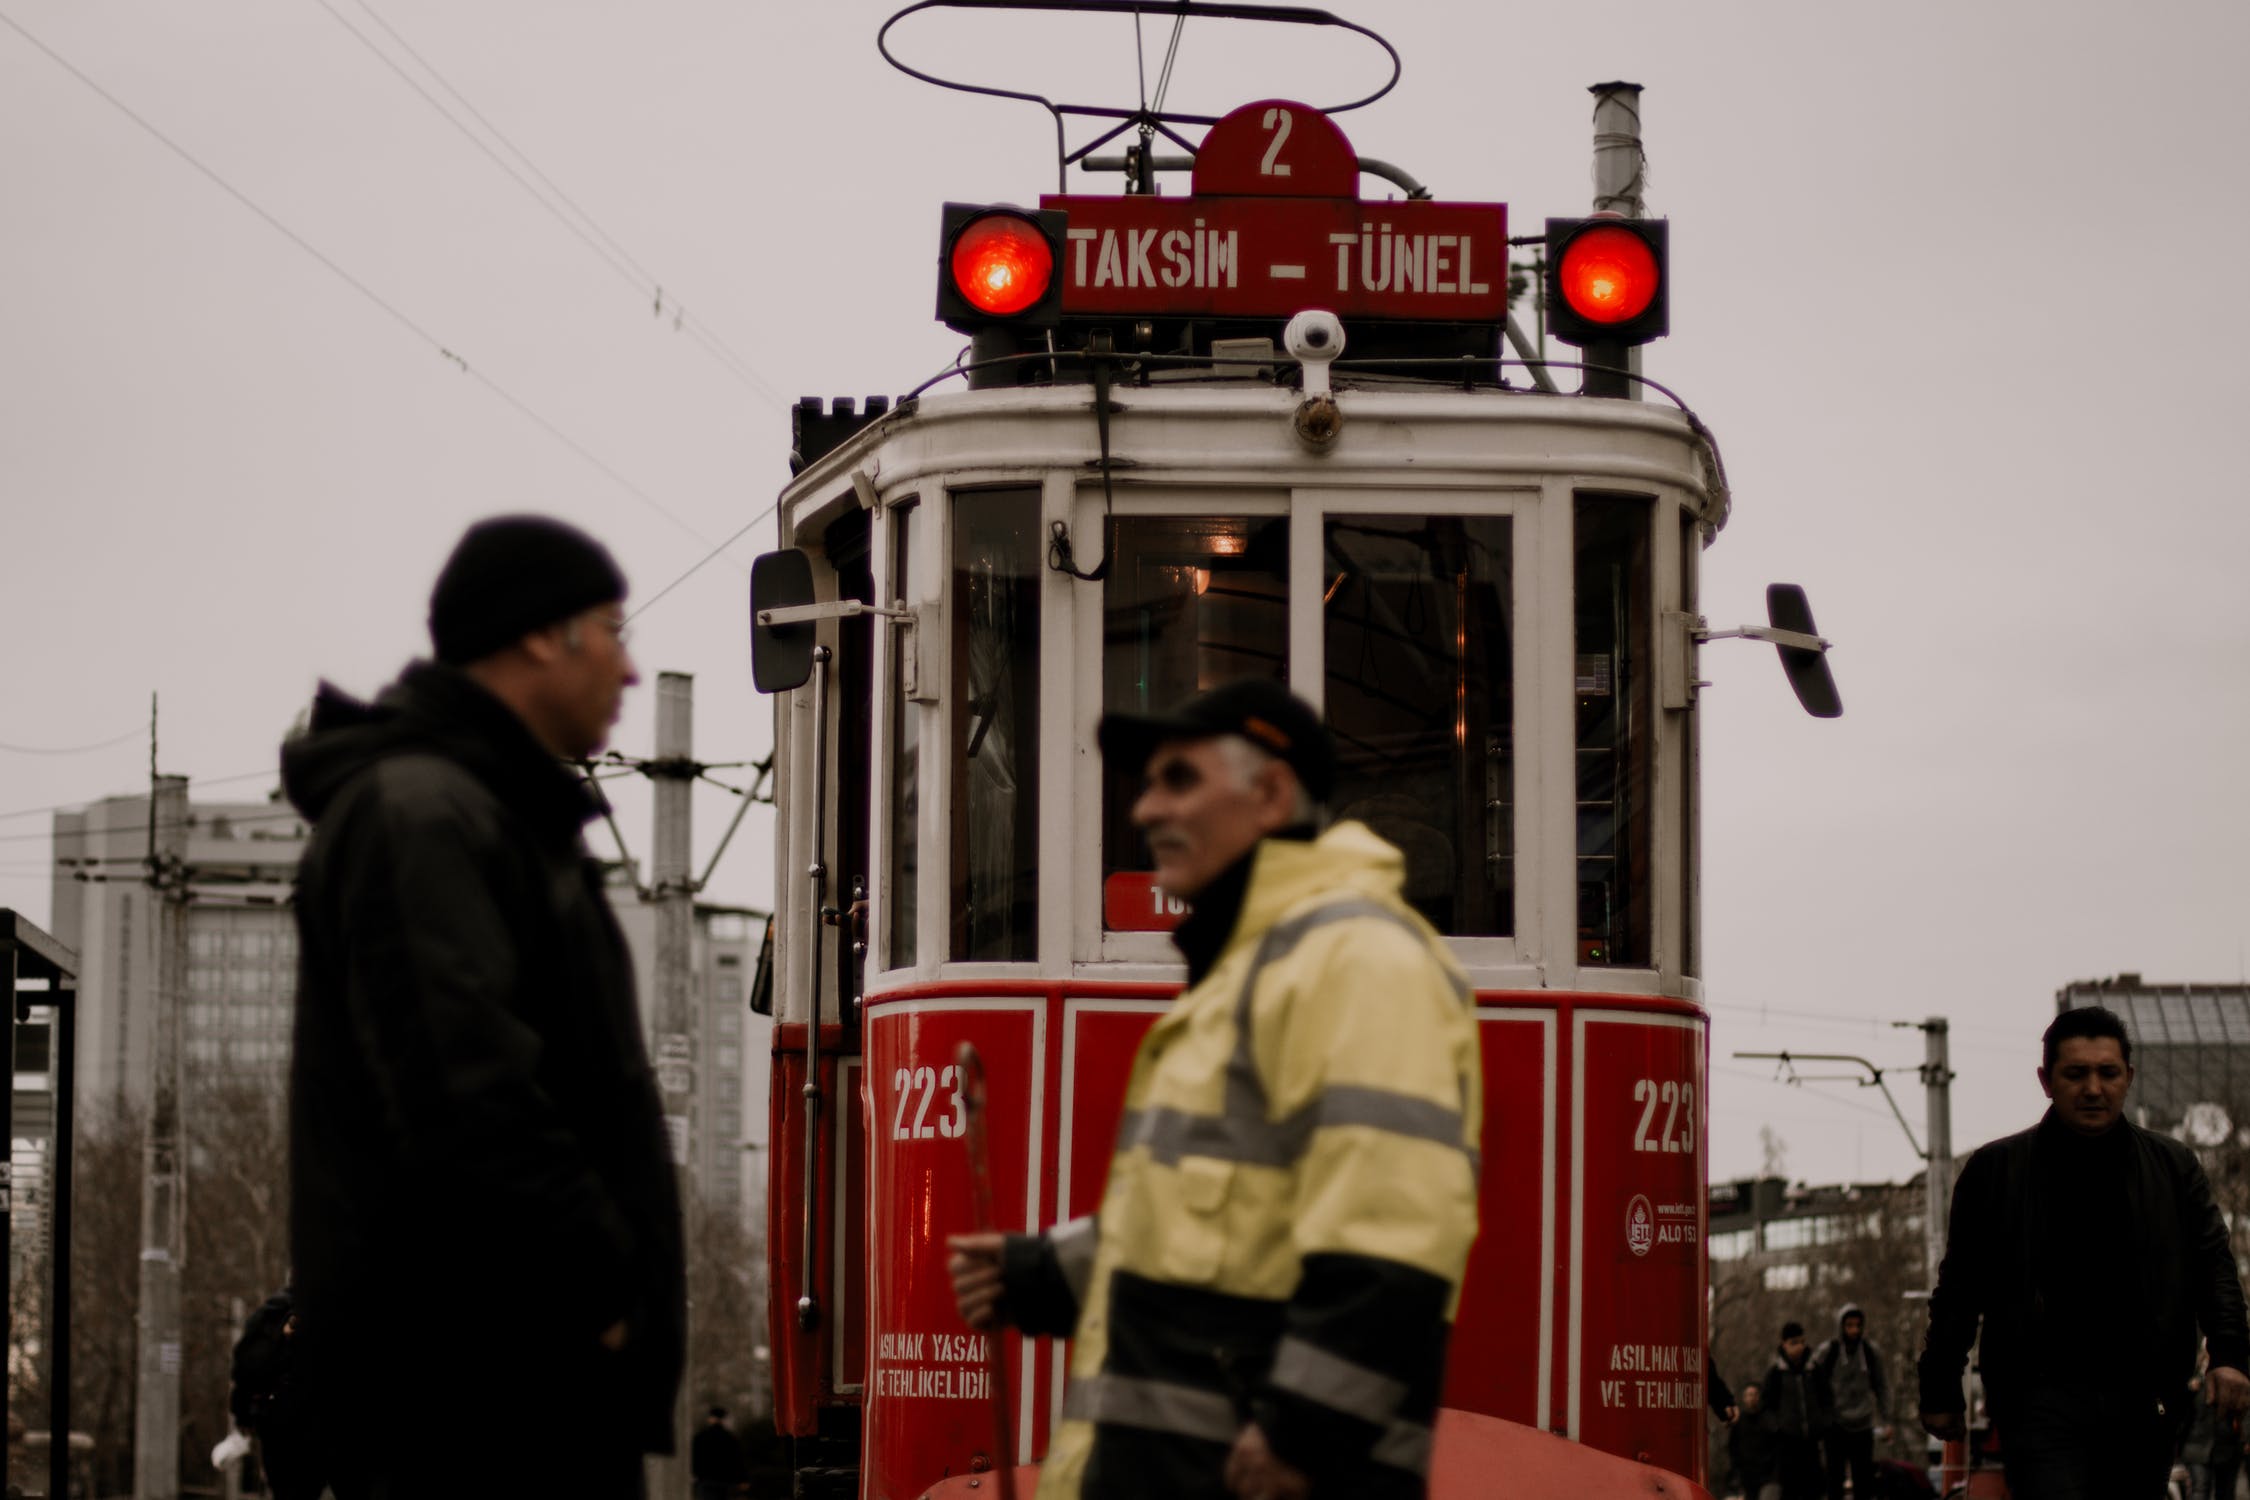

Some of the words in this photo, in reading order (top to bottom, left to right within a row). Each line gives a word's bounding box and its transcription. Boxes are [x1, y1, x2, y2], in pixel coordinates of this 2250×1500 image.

[1259, 107, 1292, 177] 2
[1066, 217, 1239, 289] TAKSİM
[1328, 222, 1490, 295] TÜNEL
[893, 1064, 968, 1140] 223
[1633, 1079, 1694, 1153] 223
[1658, 1224, 1682, 1243] ALO
[1683, 1224, 1697, 1243] 153
[879, 1332, 925, 1361] ASILMAK
[1610, 1344, 1679, 1373] ASILMAK
[1600, 1379, 1627, 1408] VE
